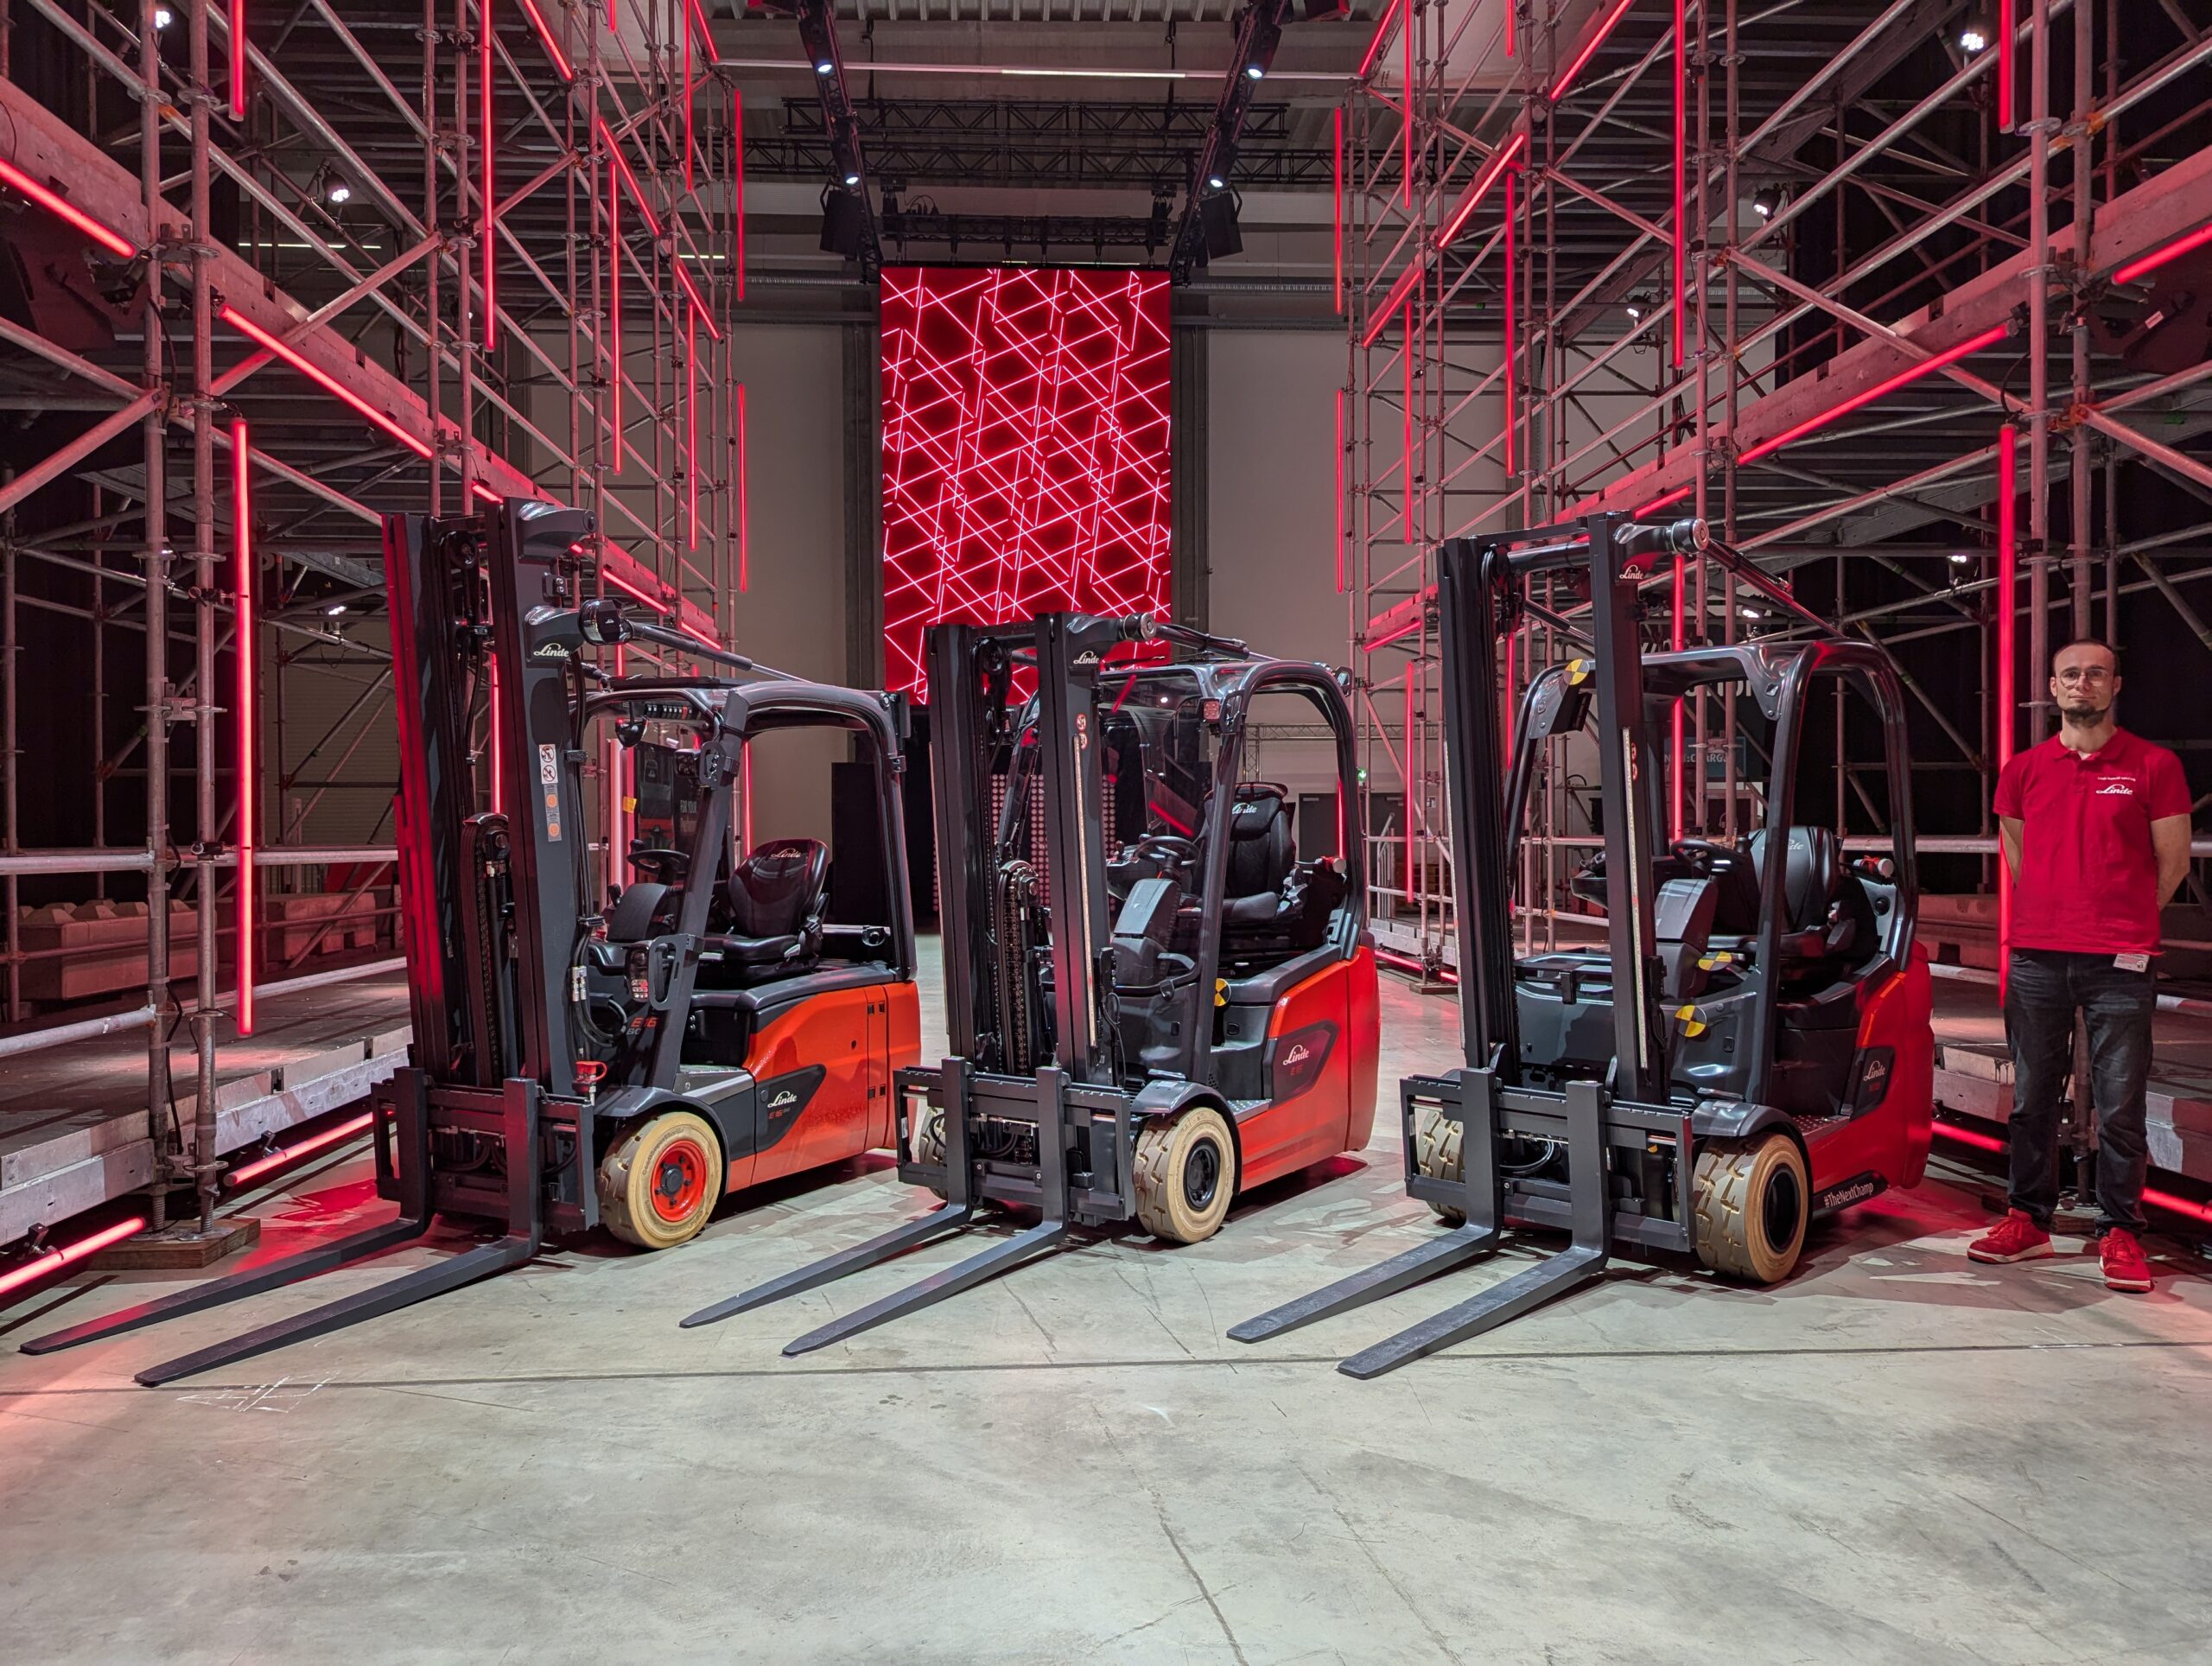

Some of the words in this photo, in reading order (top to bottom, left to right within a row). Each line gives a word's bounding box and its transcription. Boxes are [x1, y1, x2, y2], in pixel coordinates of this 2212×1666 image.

[1618, 564, 1643, 579] Linde
[533, 642, 569, 657] Linde
[1072, 650, 1099, 664] Linde
[2095, 783, 2133, 795] Linde
[770, 848, 801, 858] Linde
[1282, 1044, 1310, 1065] Linde
[1863, 1060, 1885, 1082] Linde
[767, 1091, 797, 1108] Linde
[1823, 1182, 1874, 1209] #TheNextChamp
